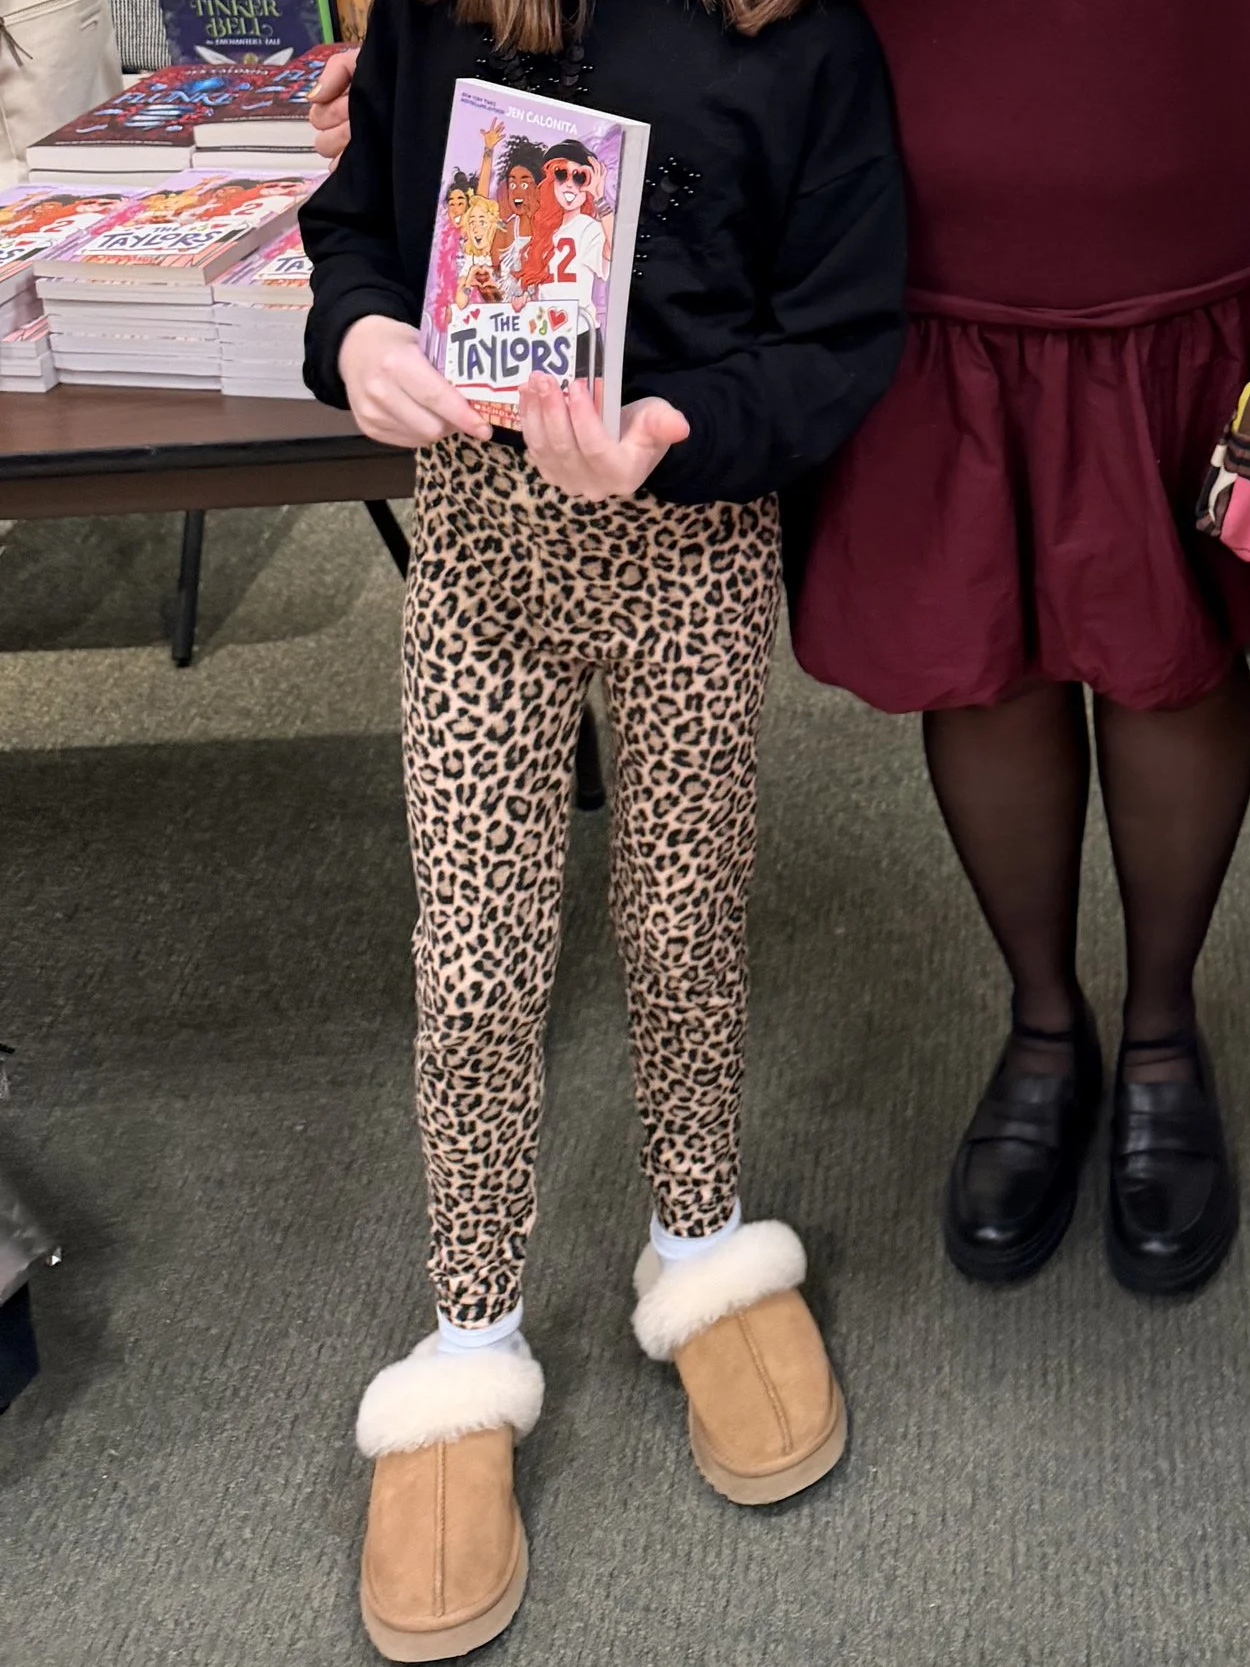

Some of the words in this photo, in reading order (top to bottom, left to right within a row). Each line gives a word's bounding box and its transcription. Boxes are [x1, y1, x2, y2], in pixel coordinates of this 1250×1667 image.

[505, 105, 526, 121] JEN
[526, 110, 579, 135] CALONITA
[99, 230, 224, 249] TAYLORS
[489, 312, 520, 332] THE
[450, 327, 572, 383] TAYLORS
